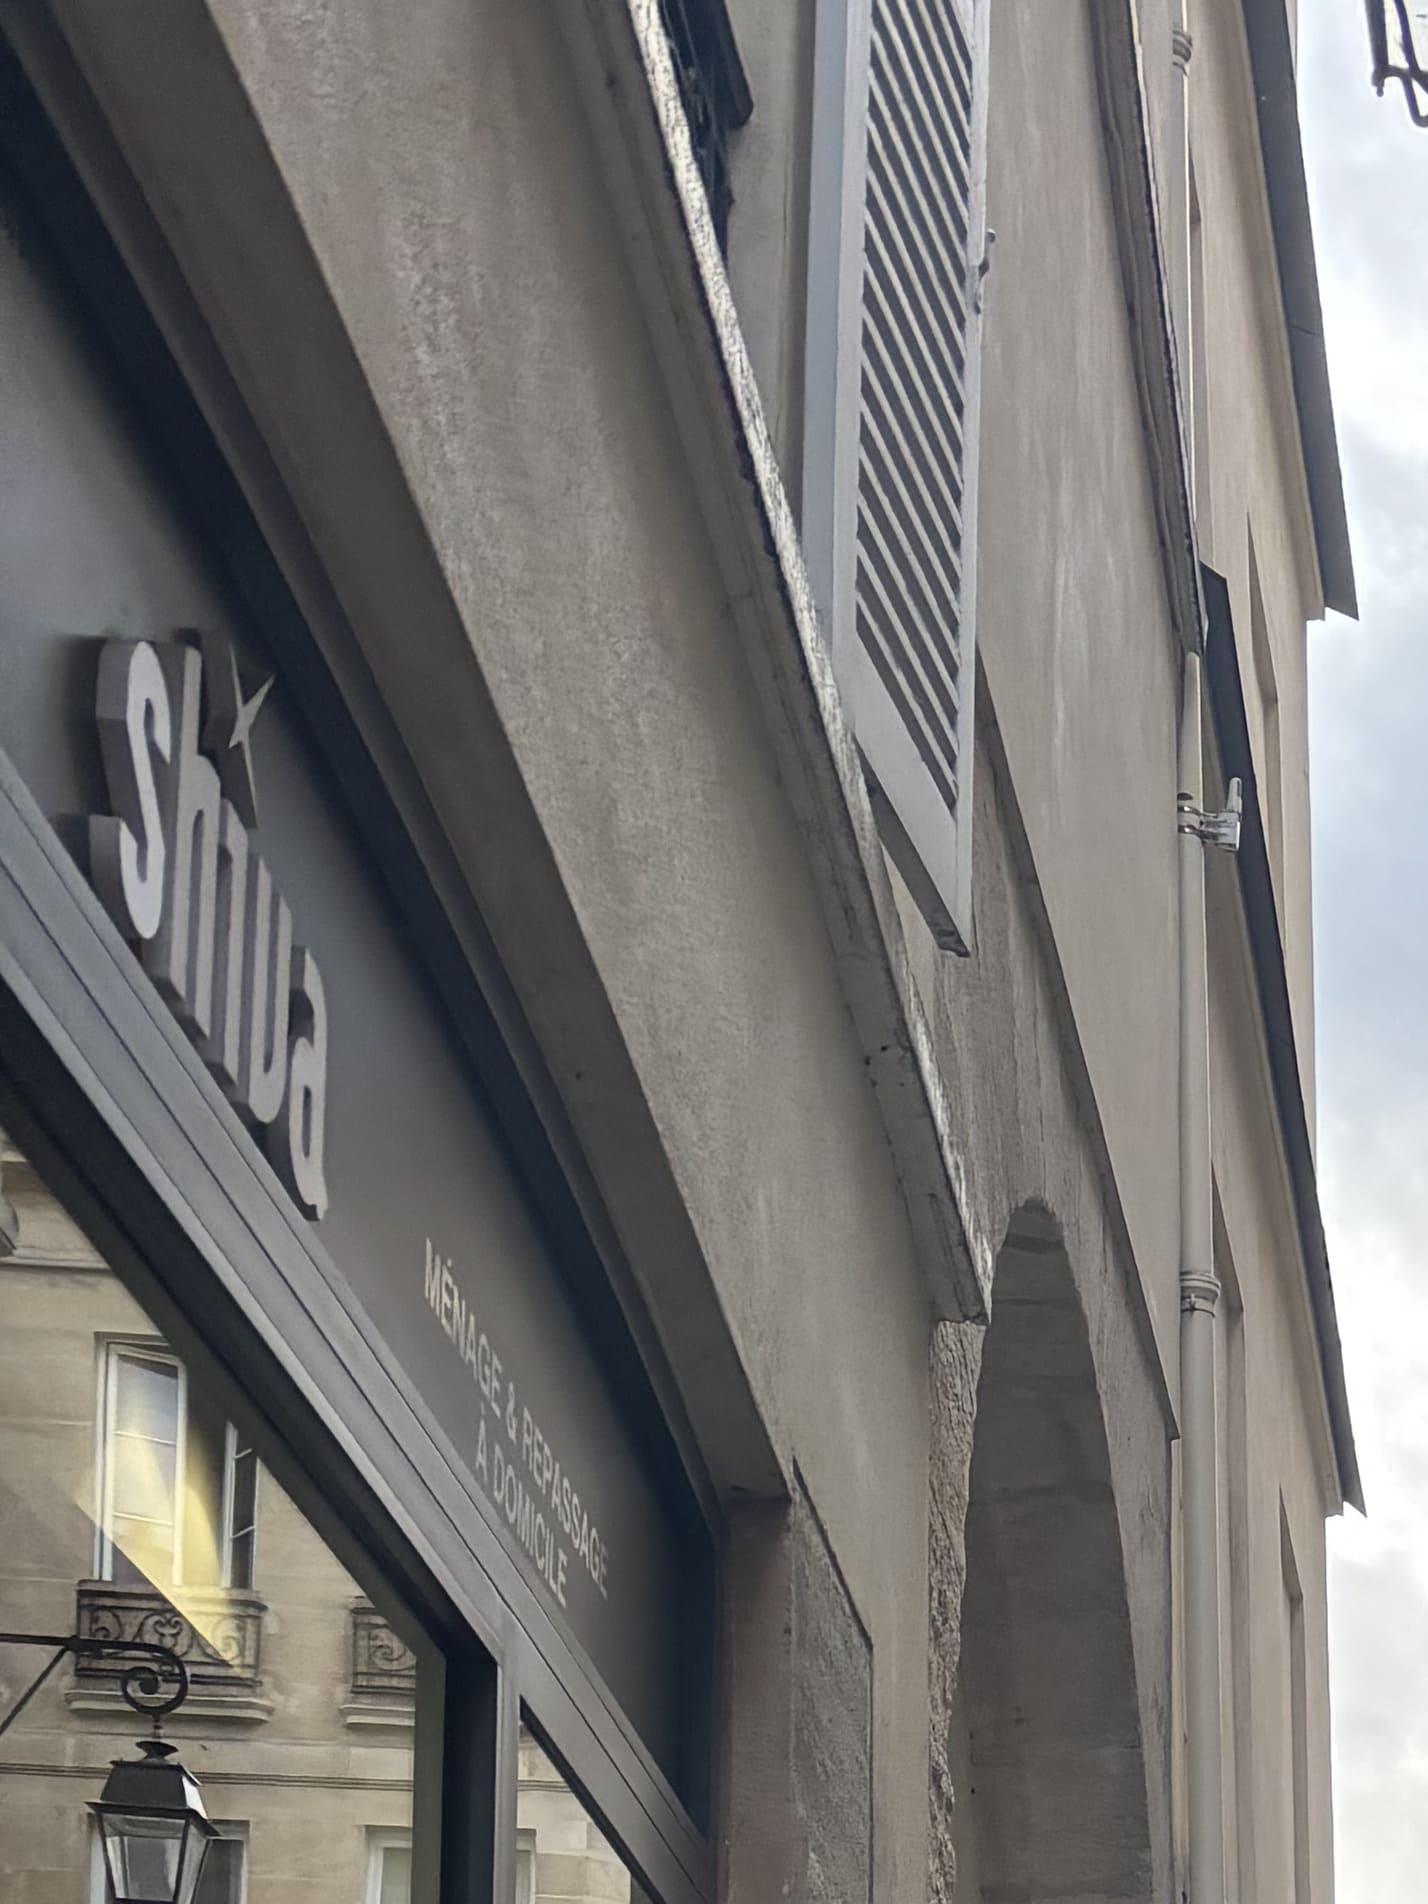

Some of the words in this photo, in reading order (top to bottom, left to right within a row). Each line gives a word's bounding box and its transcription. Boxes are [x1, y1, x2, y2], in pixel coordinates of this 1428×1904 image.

[424, 1237, 503, 1419] MÉNAGE
[506, 1381, 518, 1445] &
[522, 1407, 608, 1601] REPASSAGE
[493, 1442, 568, 1608] DOMICILE
